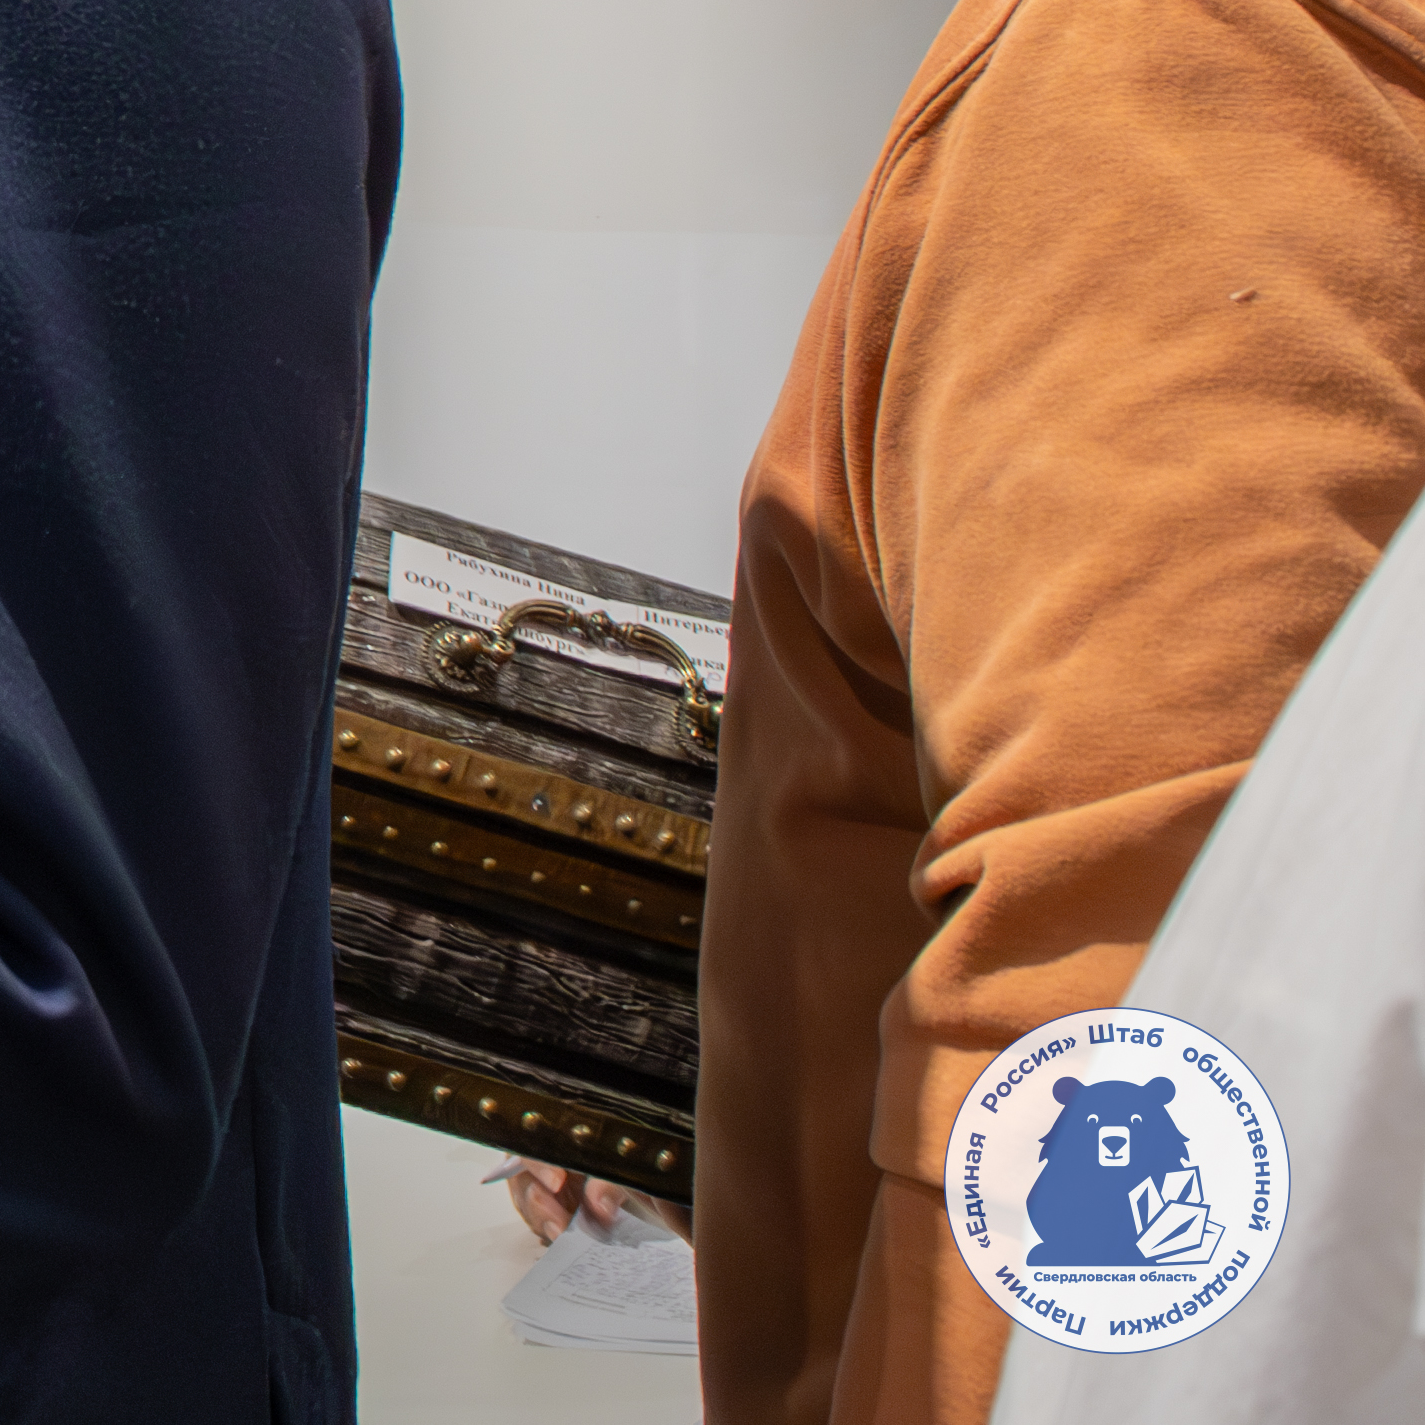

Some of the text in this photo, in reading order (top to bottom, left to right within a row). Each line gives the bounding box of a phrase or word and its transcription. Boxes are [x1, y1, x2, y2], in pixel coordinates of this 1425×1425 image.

[404, 570, 451, 594] ООО
[446, 551, 586, 606] Рябухина Нина
